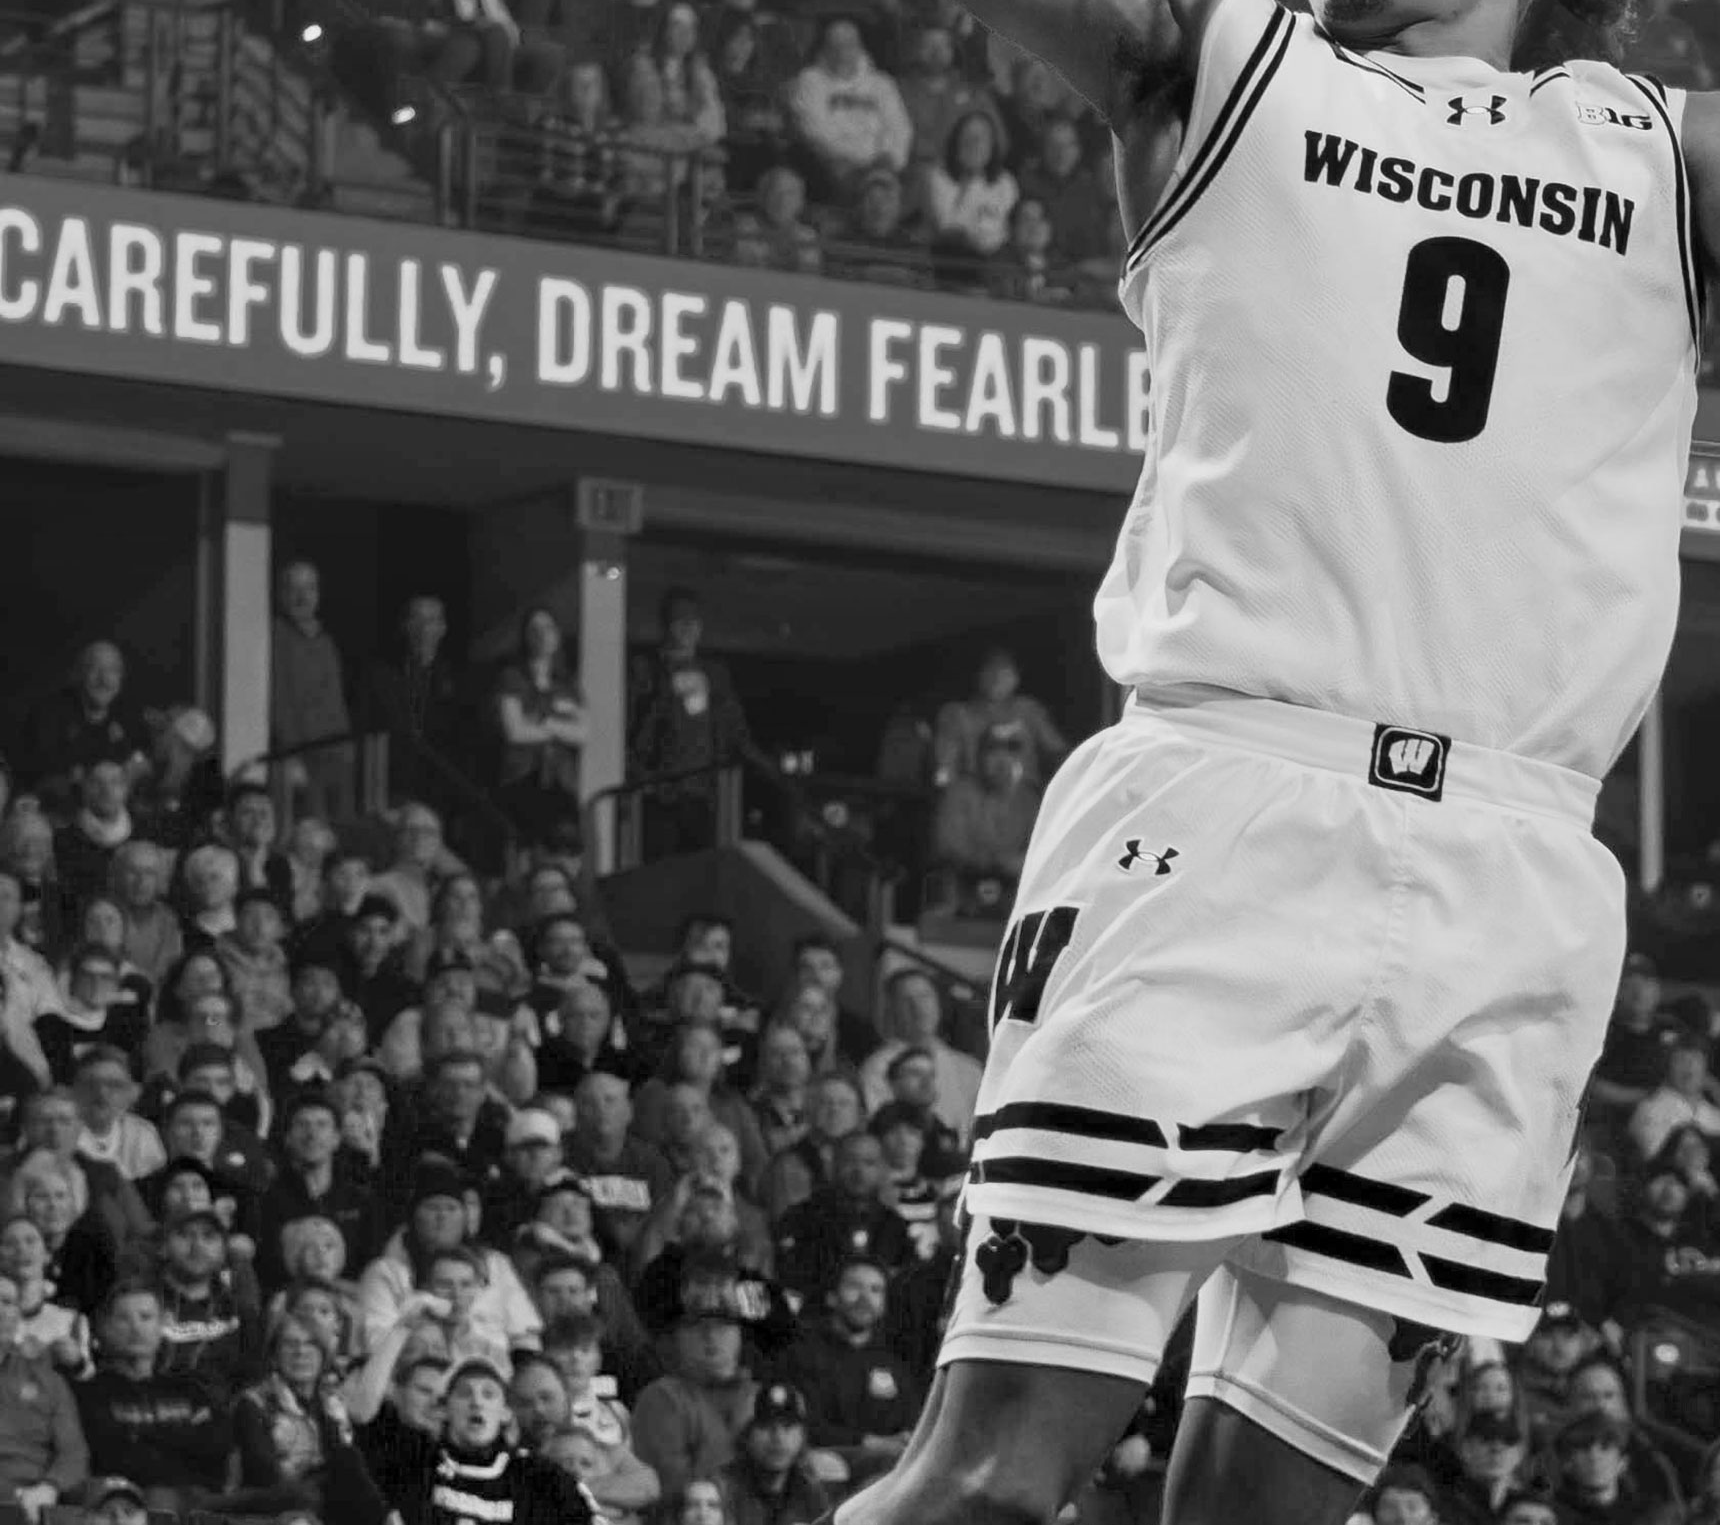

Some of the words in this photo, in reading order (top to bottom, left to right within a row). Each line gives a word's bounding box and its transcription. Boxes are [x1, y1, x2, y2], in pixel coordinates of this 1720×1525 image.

[1303, 129, 1636, 257] WISCONSIN
[0, 207, 509, 395] CAREFULLY,
[537, 276, 841, 418] DREAM
[1386, 235, 1511, 444] 9
[1388, 737, 1435, 775] W
